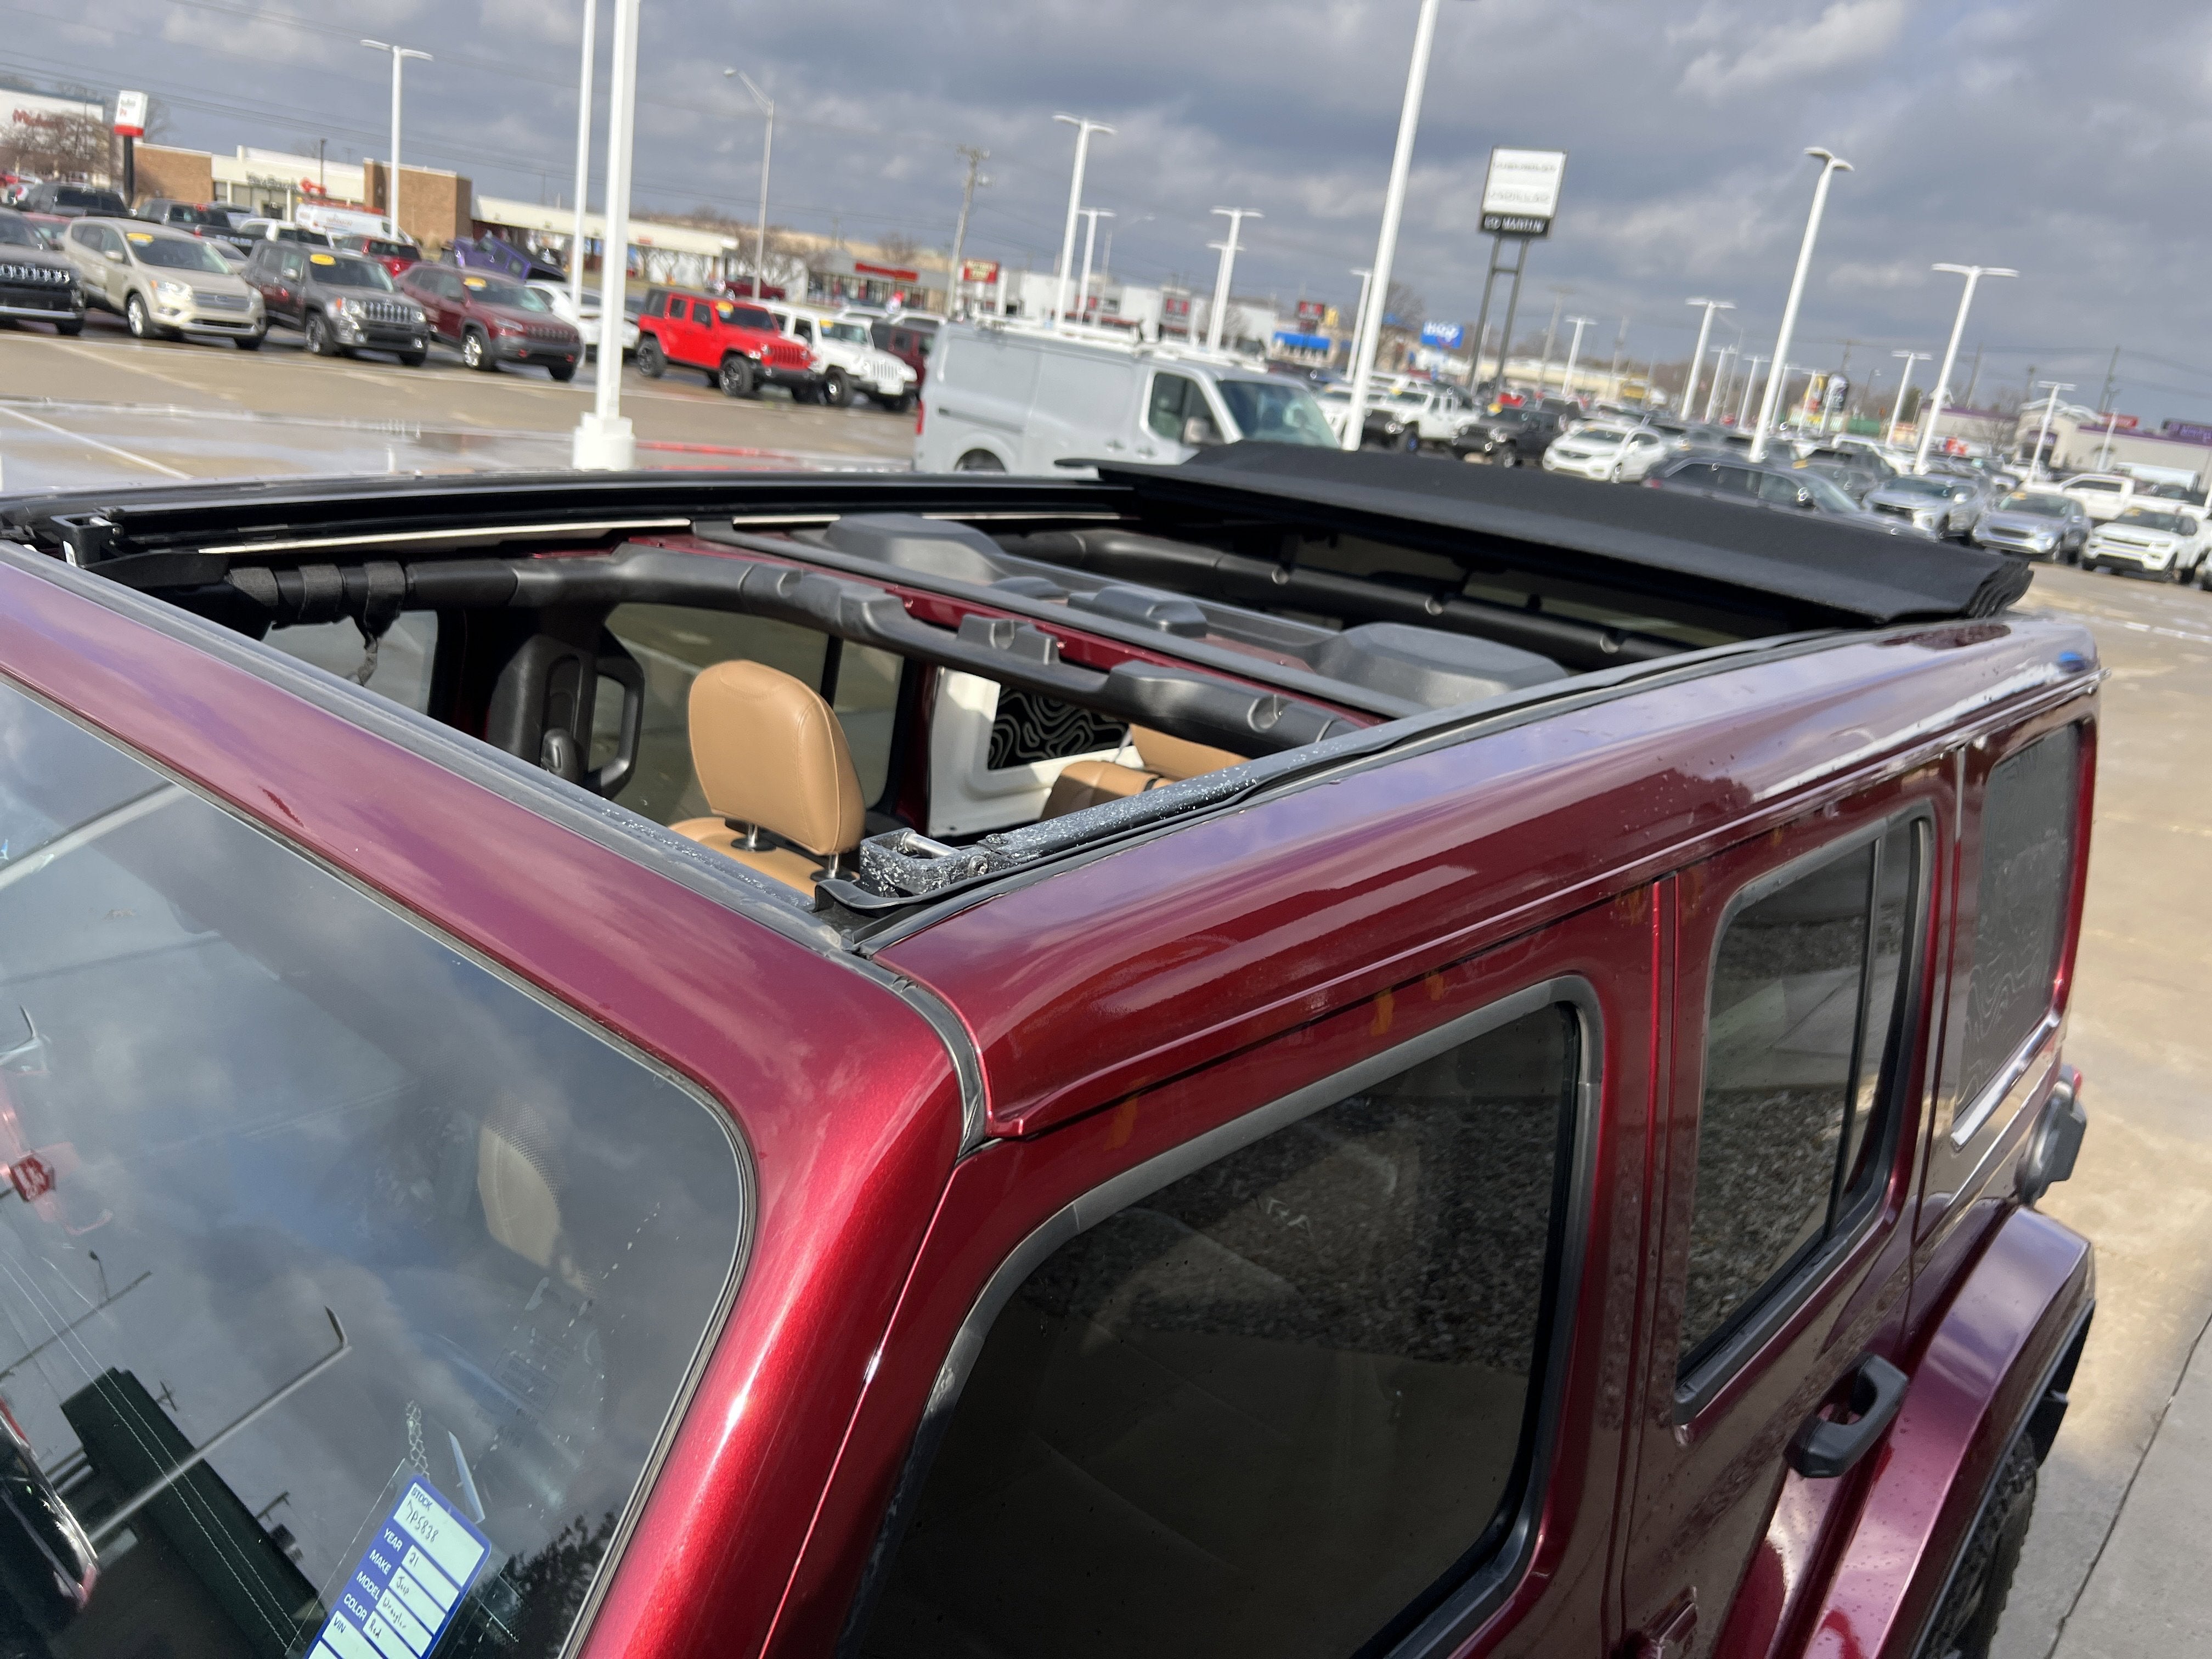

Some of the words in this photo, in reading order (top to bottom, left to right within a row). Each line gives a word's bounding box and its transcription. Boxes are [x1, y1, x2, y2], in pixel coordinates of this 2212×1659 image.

[411, 1486, 433, 1511] STOCK
[383, 1528, 403, 1552] YEAR
[369, 1549, 392, 1576] MAKE
[409, 1552, 419, 1567] 21
[356, 1571, 381, 1601] MODEL
[343, 1593, 368, 1622] COLOR
[334, 1617, 346, 1634] VIN
[369, 1618, 382, 1639] Red
